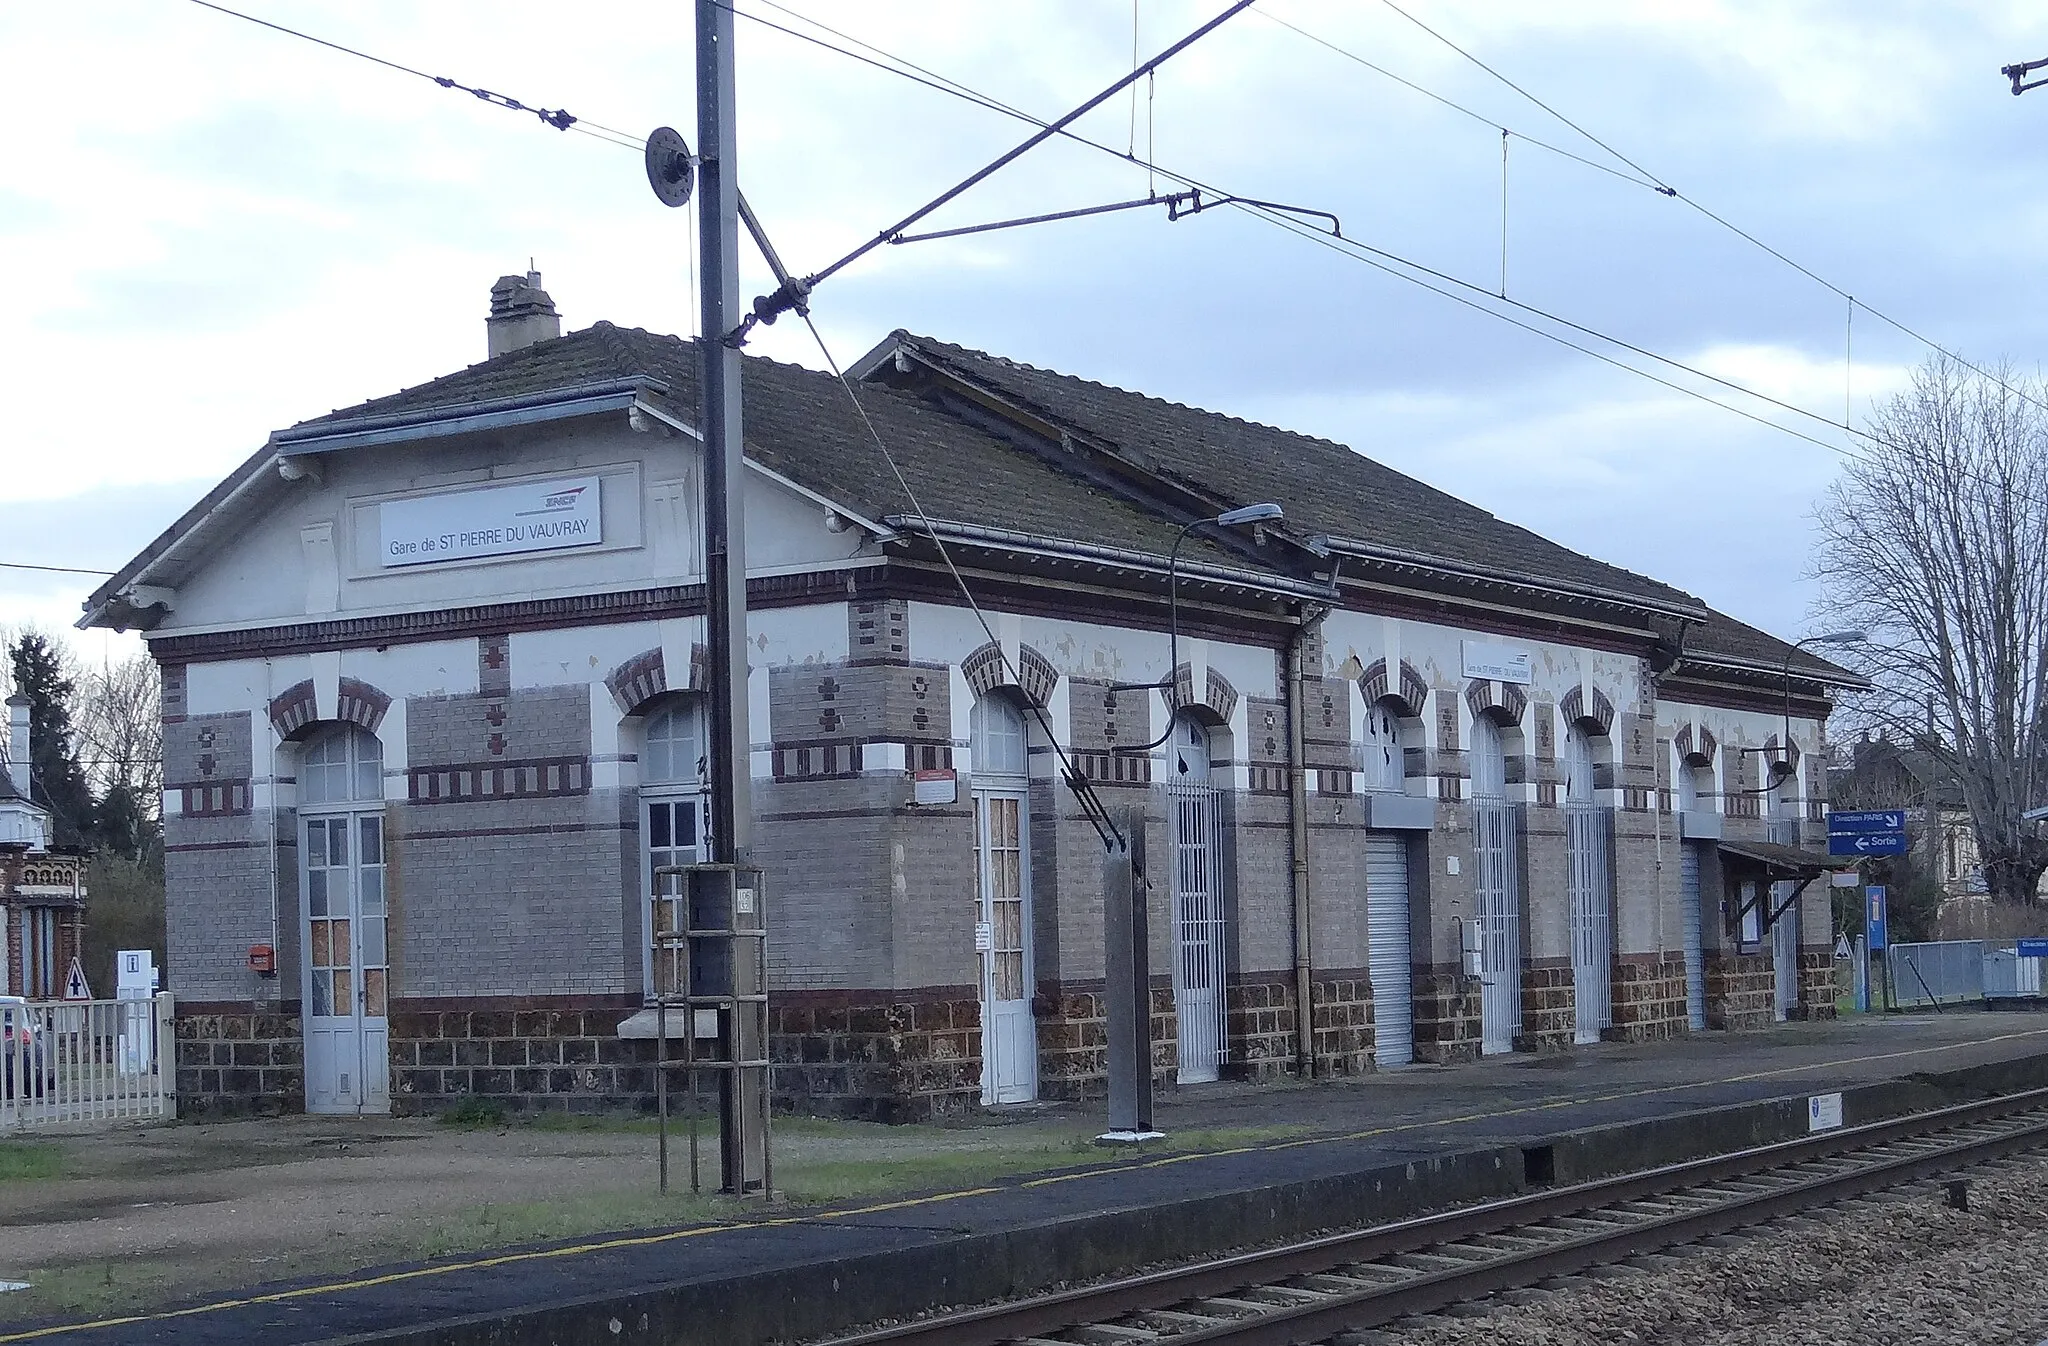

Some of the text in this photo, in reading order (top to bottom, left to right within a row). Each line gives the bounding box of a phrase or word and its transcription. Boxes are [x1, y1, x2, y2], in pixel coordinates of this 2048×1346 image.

[390, 519, 589, 556] Gare de ST PIERRE DU VAUVRAY
[1834, 813, 1883, 822] Direction PARIS
[1871, 836, 1897, 846] Sortie
